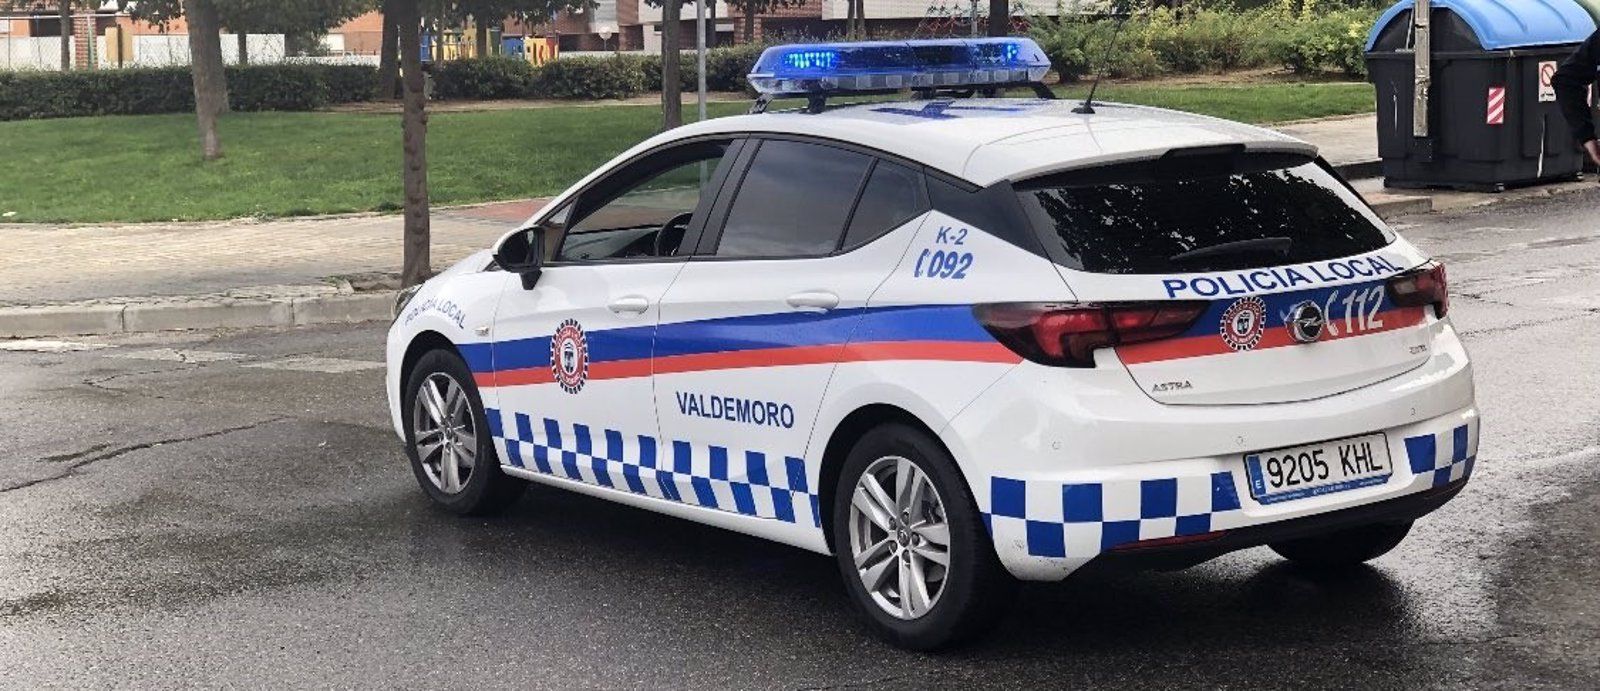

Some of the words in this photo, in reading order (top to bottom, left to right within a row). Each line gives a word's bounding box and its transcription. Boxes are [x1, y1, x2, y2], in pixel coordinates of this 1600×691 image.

[936, 226, 968, 245] K-2
[927, 250, 974, 279] 092
[1308, 255, 1404, 282] LOCAL
[436, 299, 466, 330] LOCAL
[1343, 285, 1385, 333] 112
[1152, 380, 1193, 392] ASTRA
[676, 391, 794, 429] VALDEMORO
[1267, 449, 1329, 488] 9205
[1338, 441, 1383, 477] KHL
